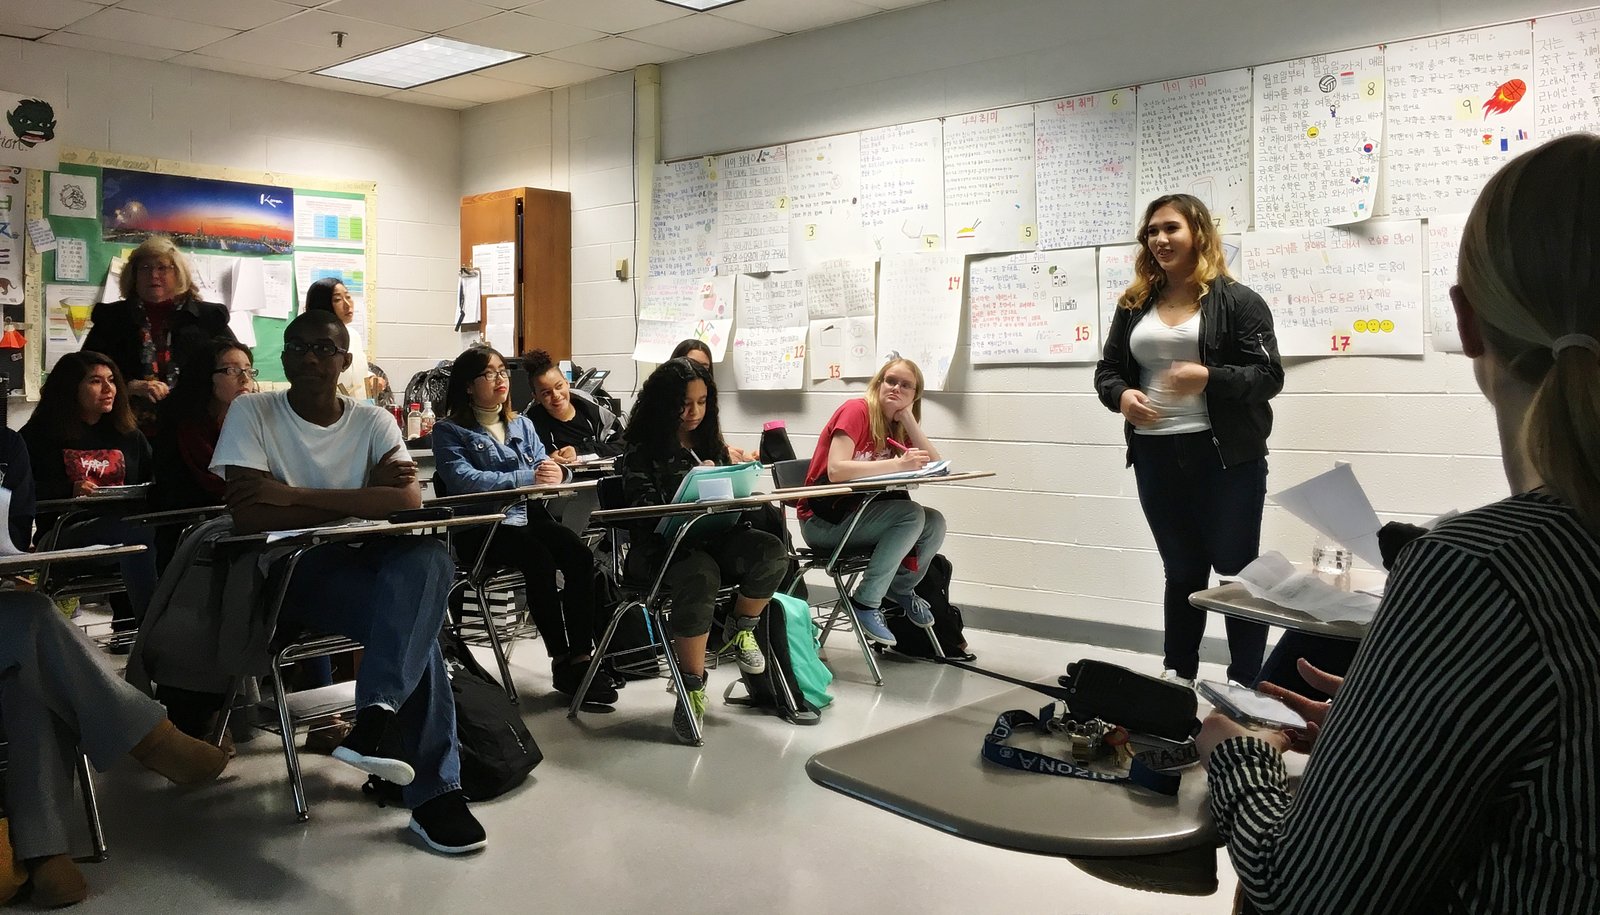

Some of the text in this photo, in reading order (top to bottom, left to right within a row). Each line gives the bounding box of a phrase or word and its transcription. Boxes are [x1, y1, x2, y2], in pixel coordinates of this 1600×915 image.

[1367, 82, 1376, 96] 8
[1111, 93, 1119, 106] 6
[1462, 99, 1473, 114] 9
[707, 157, 713, 168] 1
[779, 197, 786, 209] 2
[807, 225, 815, 237] 3
[1025, 226, 1032, 238] 5
[926, 237, 934, 248] 4
[948, 276, 961, 291] 14
[1075, 326, 1090, 342] 15
[1331, 335, 1352, 352] 17
[794, 344, 805, 359] 12
[828, 365, 841, 379] 13
